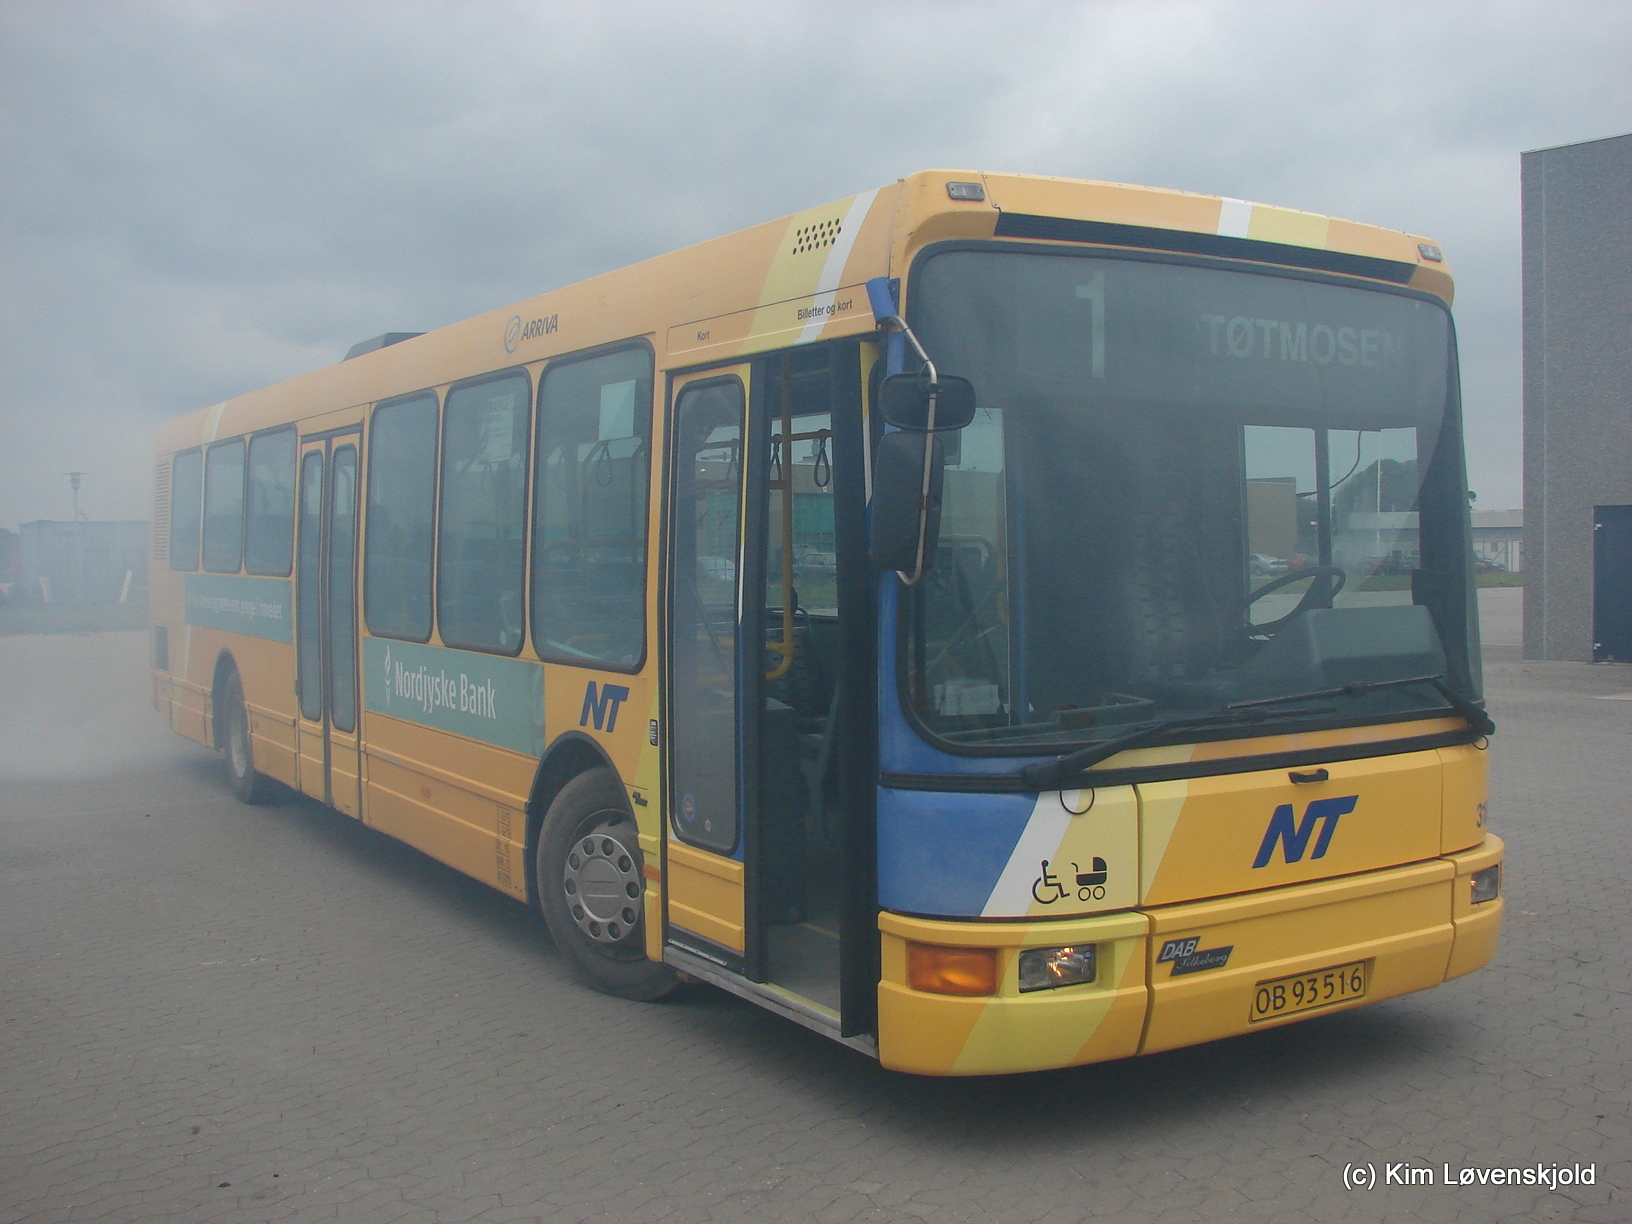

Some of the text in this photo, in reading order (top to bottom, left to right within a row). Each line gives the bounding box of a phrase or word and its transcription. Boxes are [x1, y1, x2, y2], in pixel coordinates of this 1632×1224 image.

[521, 314, 558, 341] ARRIVA
[797, 299, 853, 320] Billetter og kort
[1076, 270, 1105, 378] 1
[697, 331, 710, 341] Kort
[1200, 313, 1402, 368] TØTMOSEN
[395, 661, 497, 720] Nordjyske Bank
[579, 680, 630, 733] NT
[1251, 794, 1359, 869] NT
[1161, 940, 1197, 960] DAB
[1256, 985, 1286, 1014] OB
